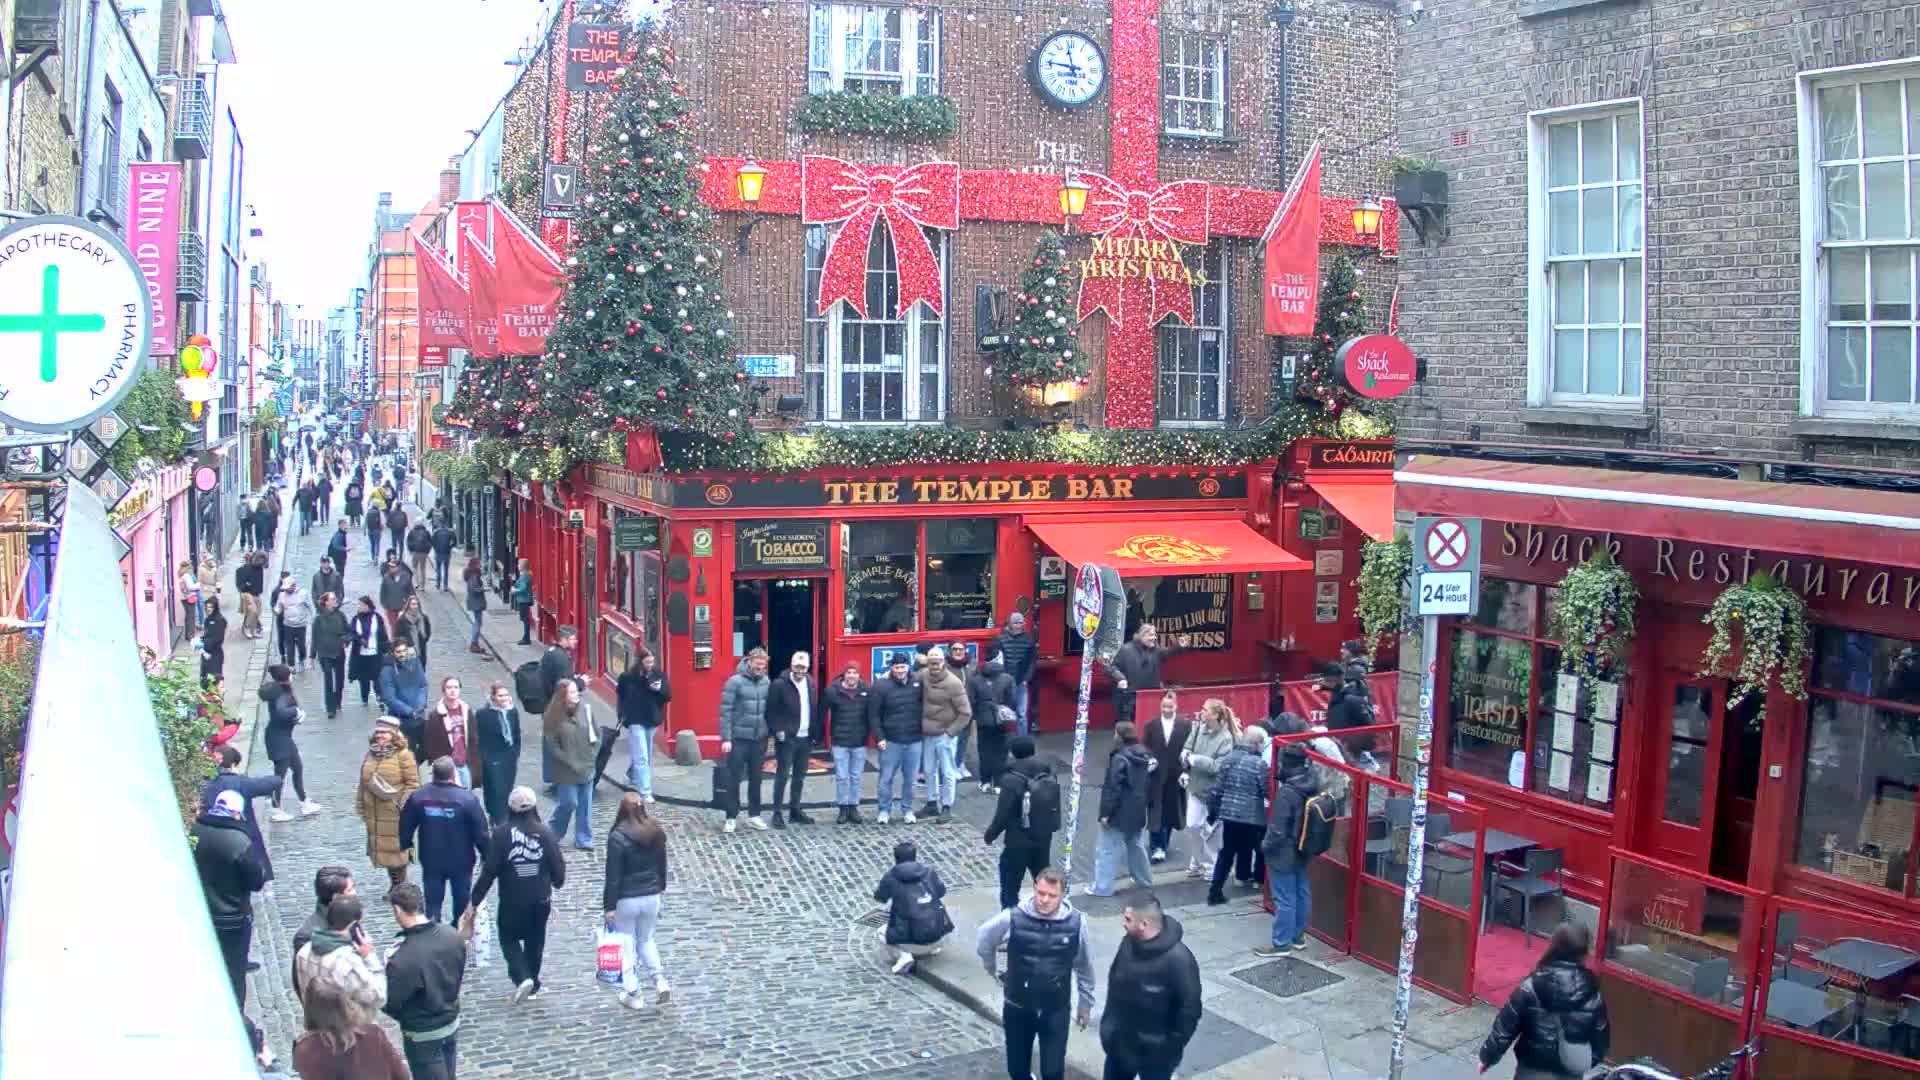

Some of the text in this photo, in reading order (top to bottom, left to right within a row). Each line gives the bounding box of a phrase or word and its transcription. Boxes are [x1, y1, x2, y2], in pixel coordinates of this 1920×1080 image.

[585, 30, 619, 45] THE
[570, 48, 633, 64] TEMPLE
[1037, 140, 1083, 163] THE
[136, 170, 170, 234] NINE
[0, 232, 114, 270] APOTHECARY
[1090, 237, 1185, 262] MERRY
[1285, 273, 1304, 284] THE
[1270, 283, 1312, 299] TEMPL
[522, 304, 546, 314] THE
[1279, 299, 1305, 314] BAR
[502, 314, 554, 327] TEMPL
[518, 326, 549, 338] BAR
[89, 302, 137, 401] PHARMACY
[824, 478, 1134, 504] THE TEMPLE BAR
[751, 538, 817, 561] TOBACCO
[1502, 521, 1622, 567] Shack
[874, 554, 891, 563] THE
[1177, 578, 1227, 593] EMPEROR
[1213, 593, 1225, 608] OF
[1422, 584, 1444, 603] 24
[1445, 594, 1468, 603] HOUR
[1151, 617, 1183, 632] ALTED
